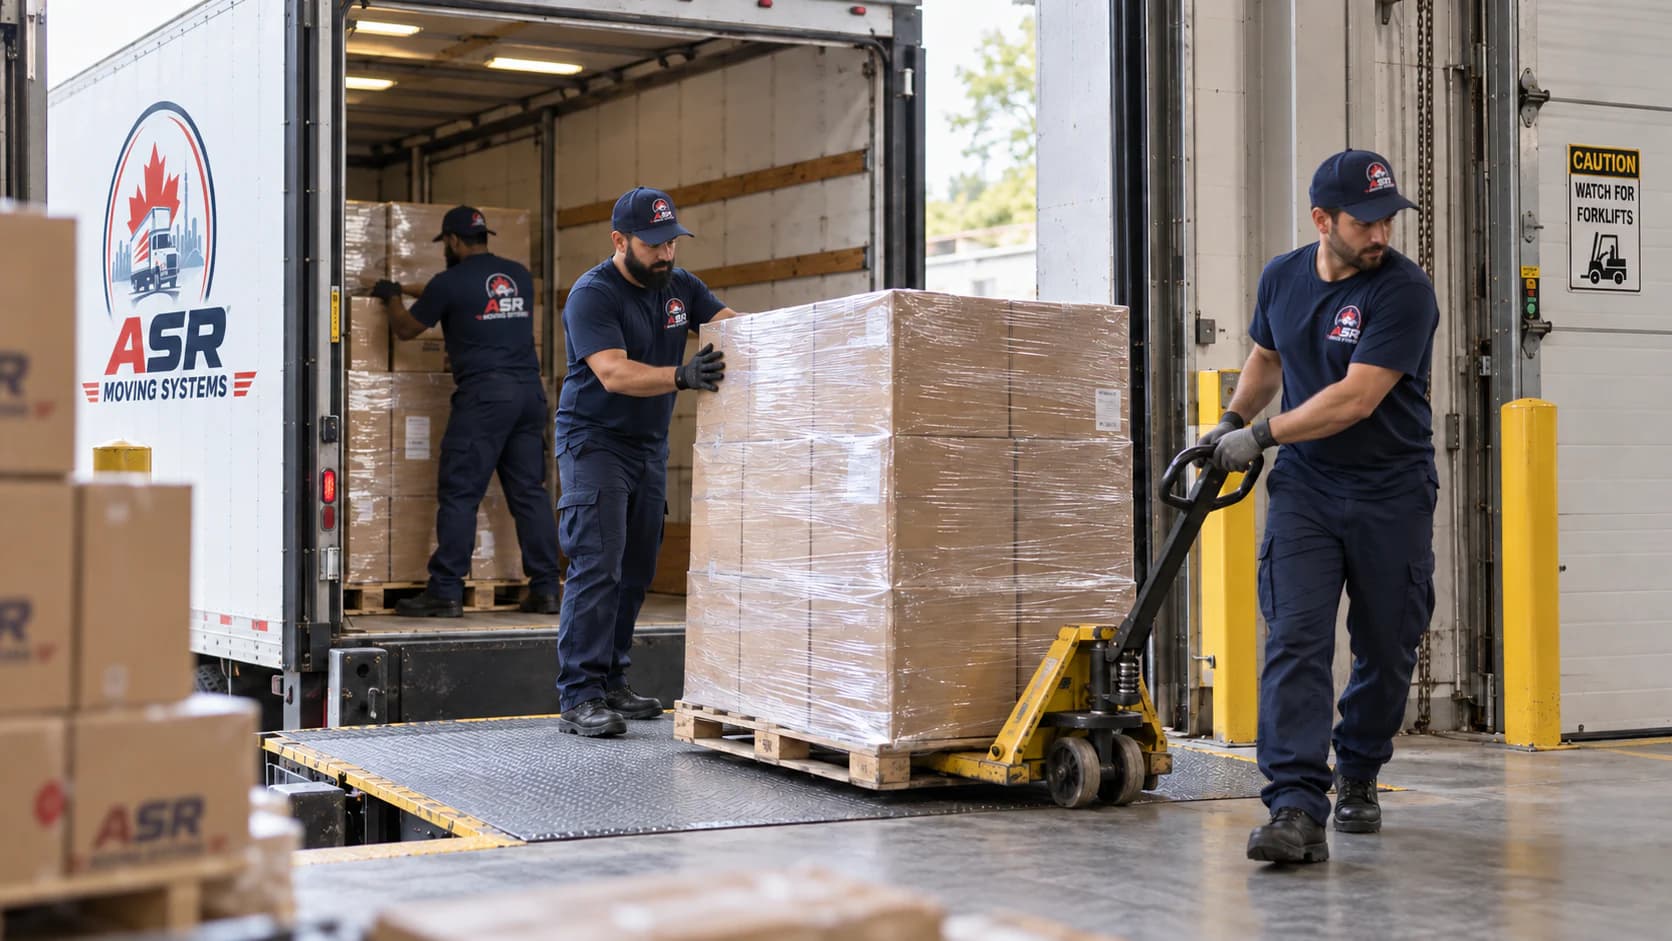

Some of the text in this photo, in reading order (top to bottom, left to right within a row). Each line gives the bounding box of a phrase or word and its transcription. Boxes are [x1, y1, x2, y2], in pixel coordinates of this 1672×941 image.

[1573, 151, 1636, 174] CAUTION
[1575, 182, 1635, 201] WATCH FOR
[1577, 207, 1634, 225] FORKLIFTS
[484, 297, 524, 314] ASR
[104, 306, 227, 376] ASR
[1329, 325, 1360, 339] ASR
[103, 375, 227, 402] MOVING SYSTEMS
[93, 795, 205, 848] ASR
